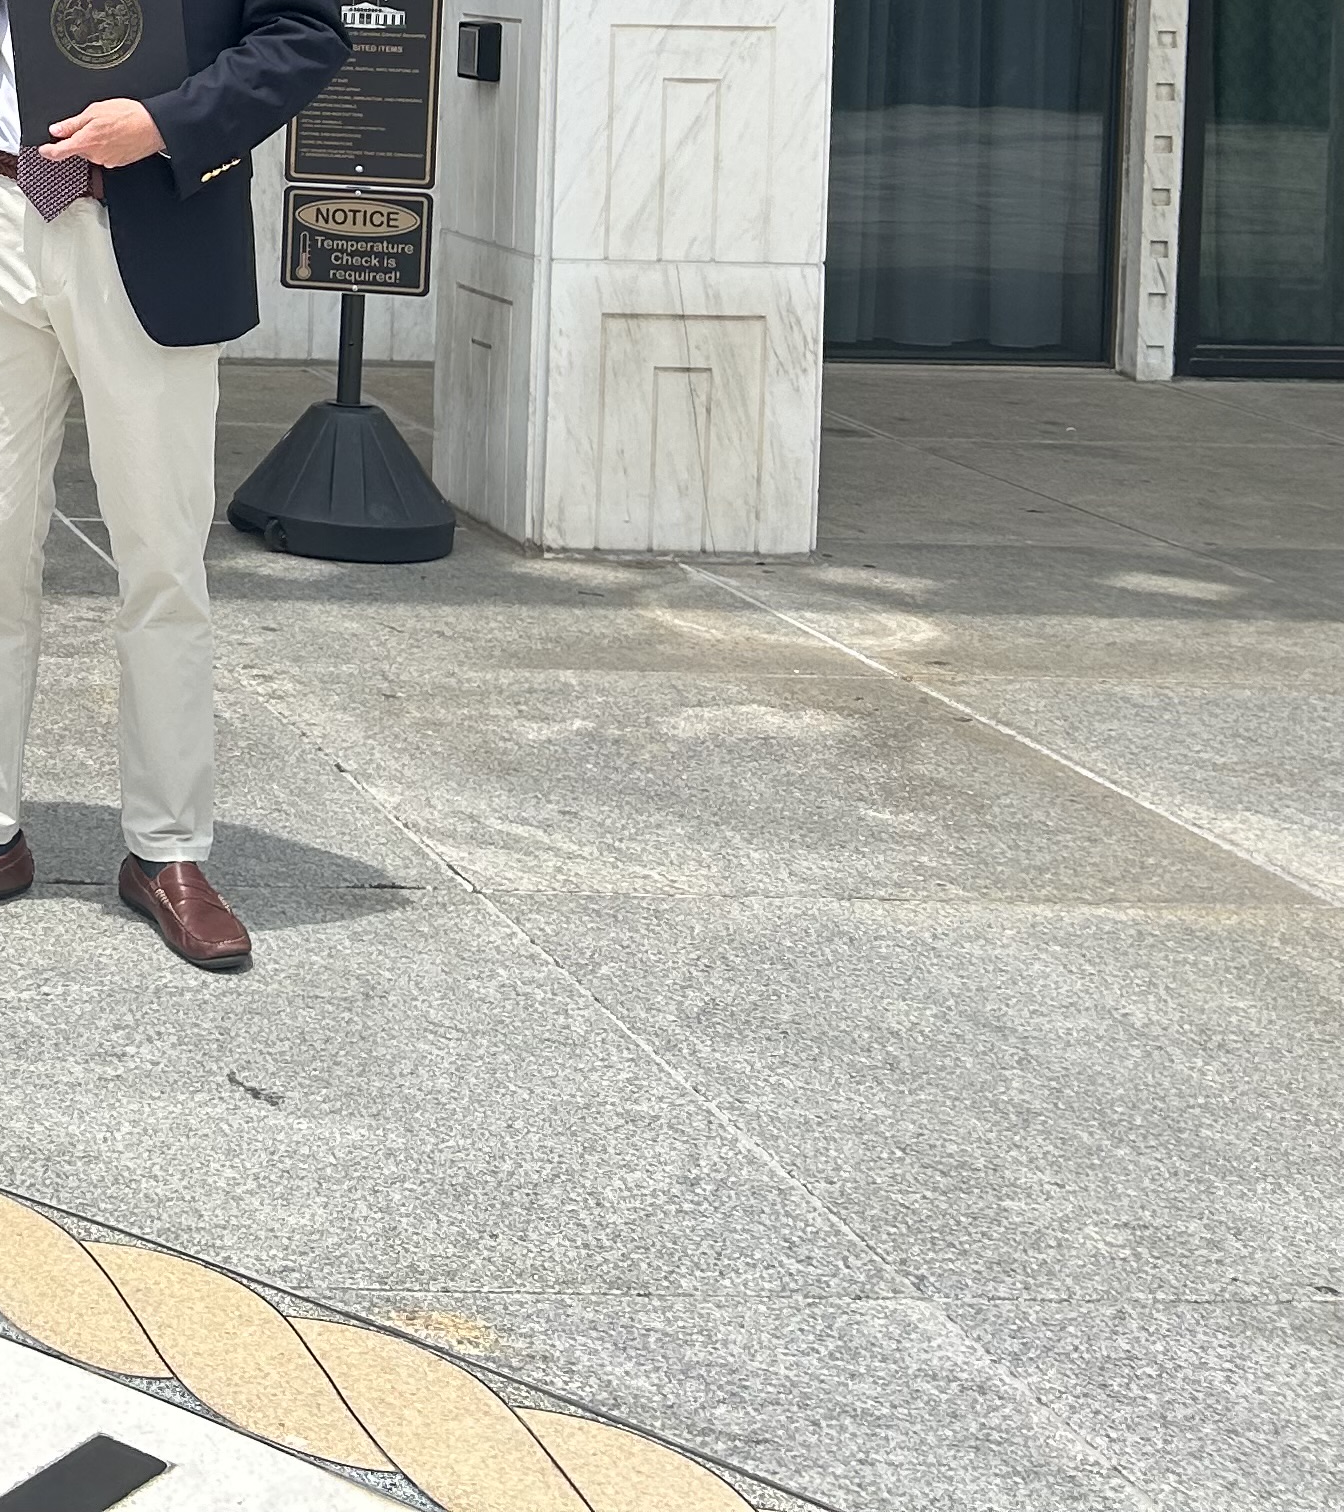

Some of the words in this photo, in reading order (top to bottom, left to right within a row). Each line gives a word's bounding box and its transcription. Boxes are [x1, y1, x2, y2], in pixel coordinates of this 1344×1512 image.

[315, 207, 400, 228] NOTICE
[315, 236, 414, 254] Temperature
[331, 252, 379, 267] Check
[384, 256, 396, 268] is
[330, 269, 400, 283] required!
